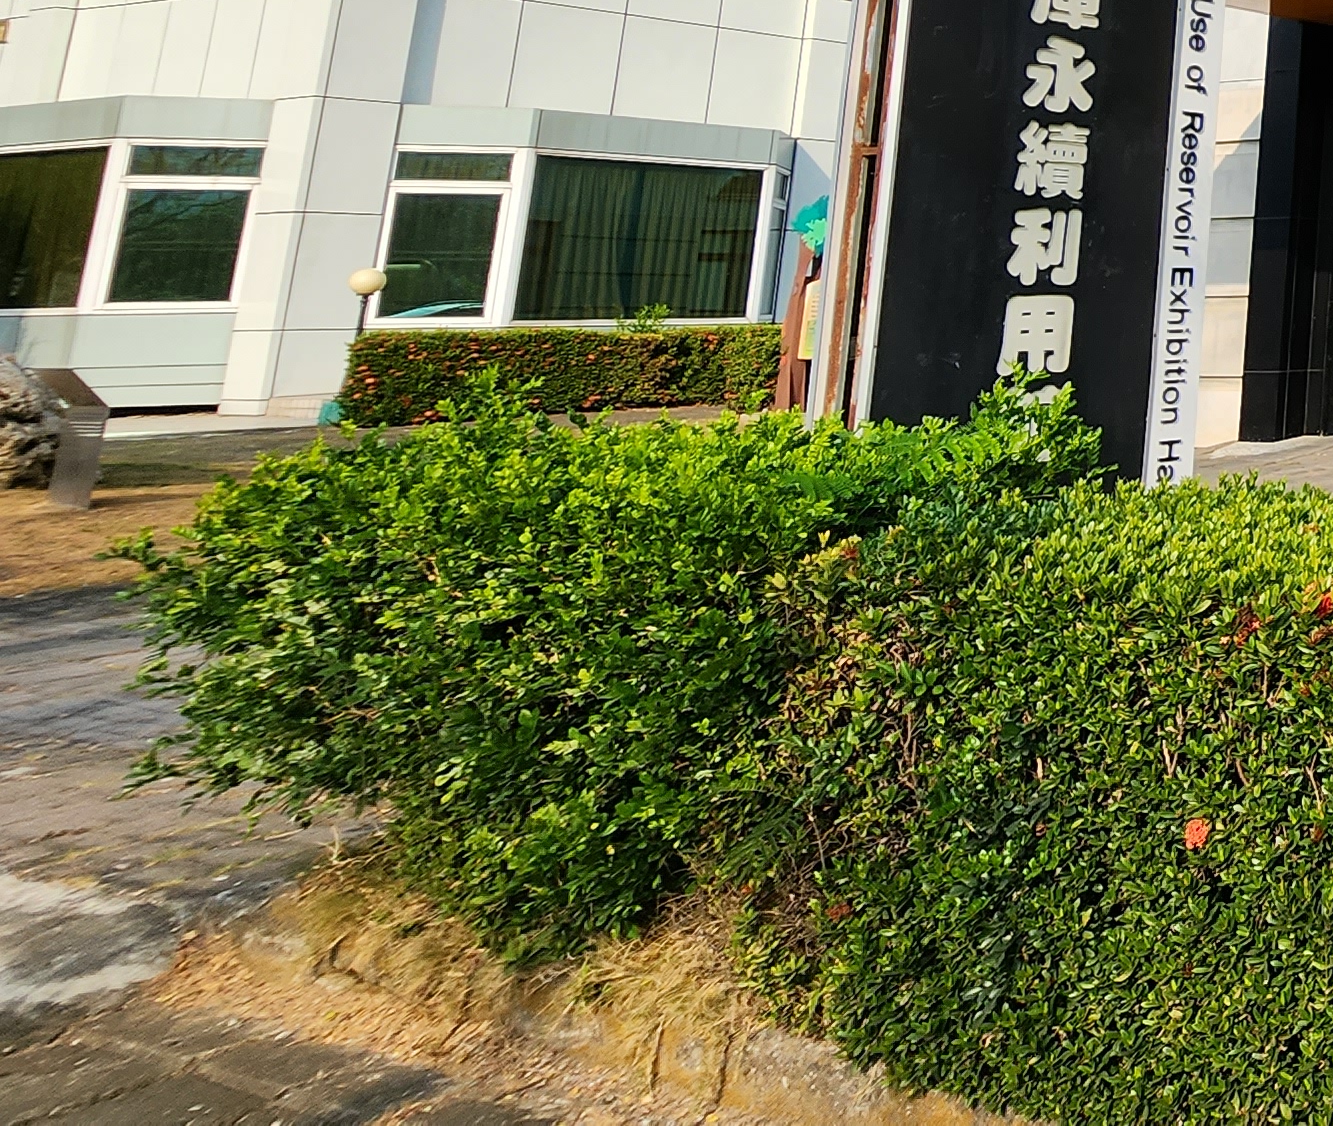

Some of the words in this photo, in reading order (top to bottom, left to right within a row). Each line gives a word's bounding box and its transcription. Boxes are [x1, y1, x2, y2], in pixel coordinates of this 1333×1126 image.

[1184, 64, 1208, 97] of
[1172, 110, 1204, 258] Reservoir
[1160, 267, 1195, 426] Exhibition
